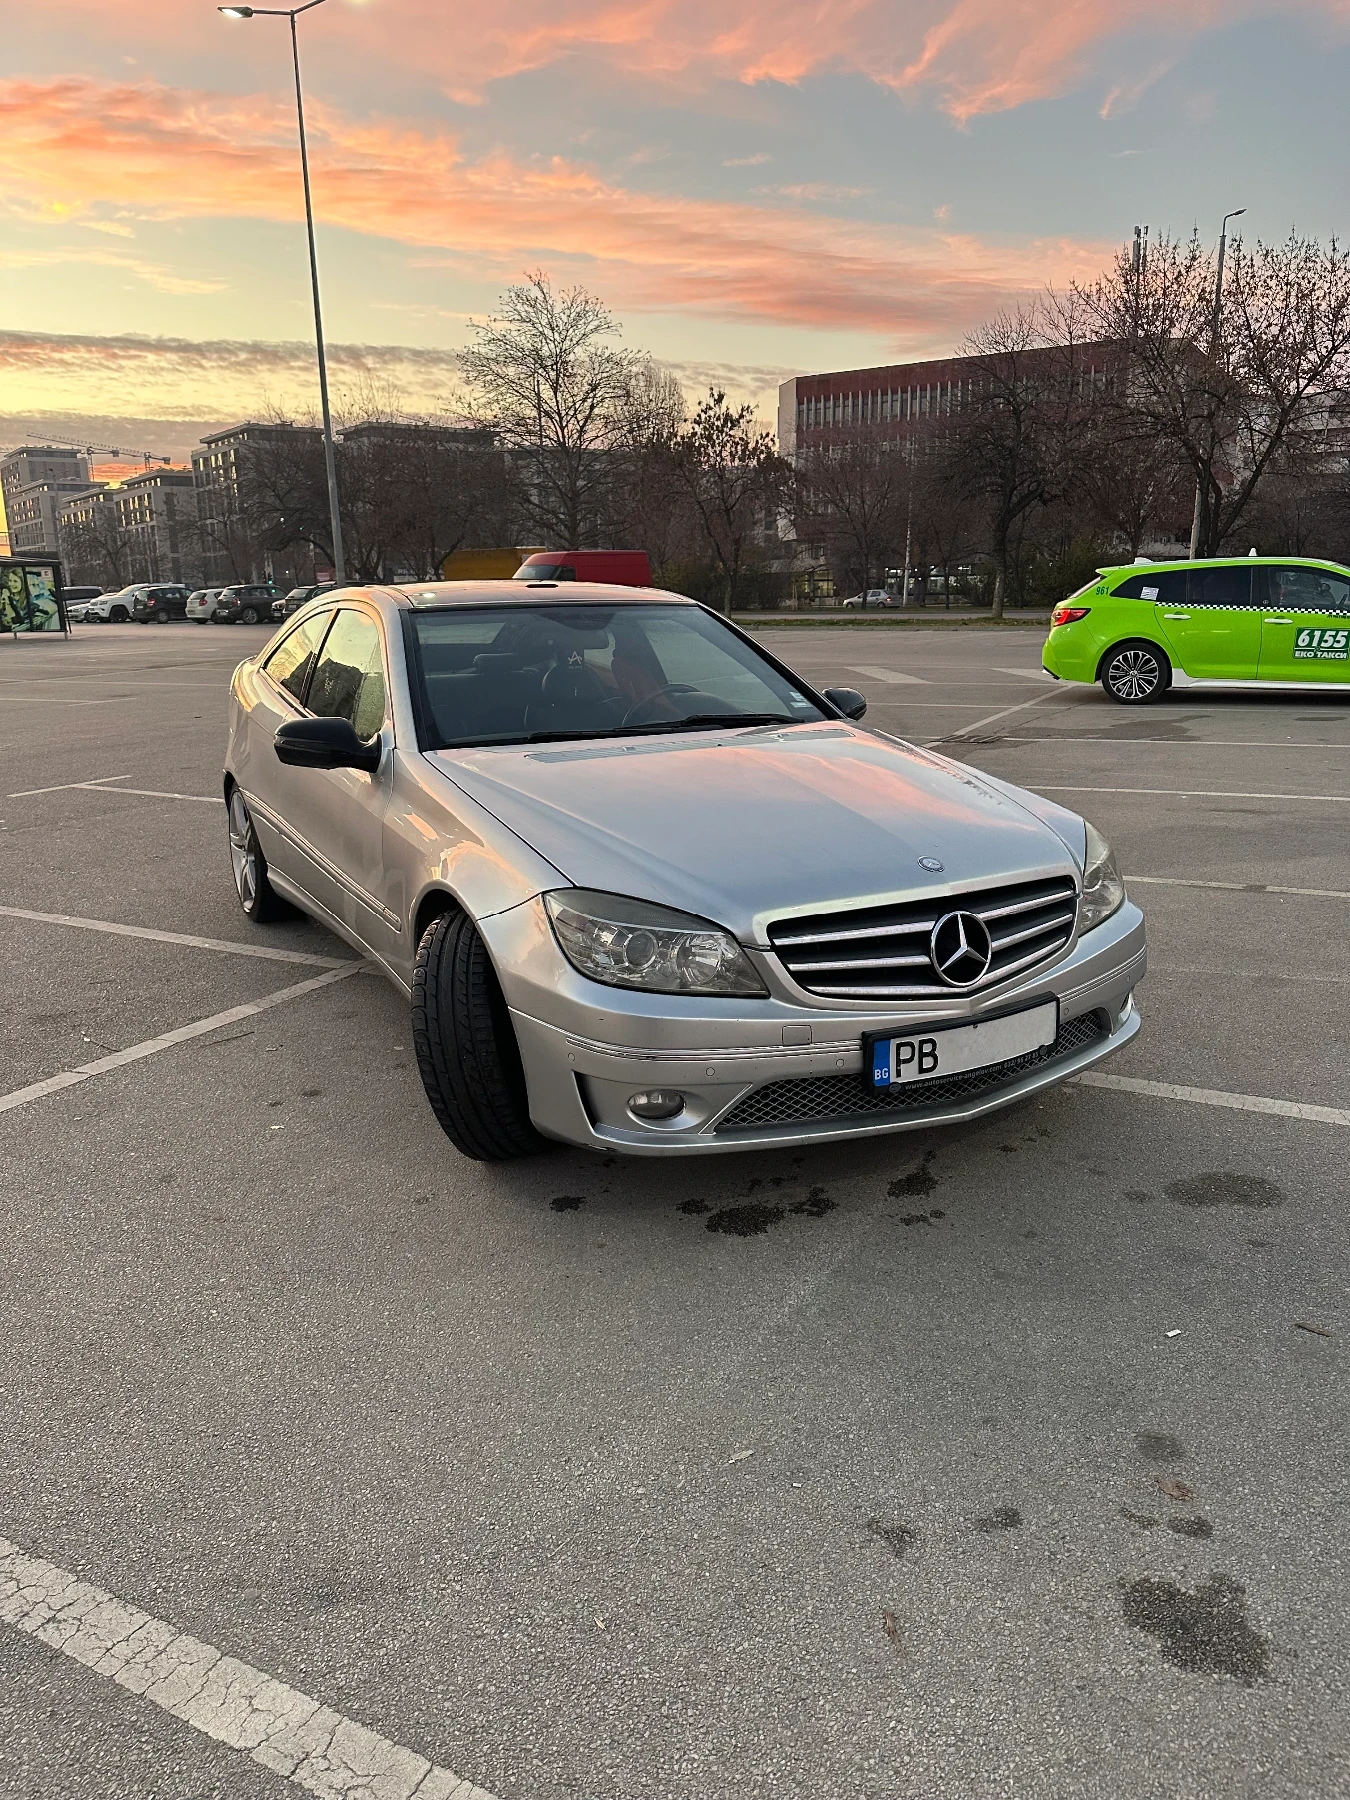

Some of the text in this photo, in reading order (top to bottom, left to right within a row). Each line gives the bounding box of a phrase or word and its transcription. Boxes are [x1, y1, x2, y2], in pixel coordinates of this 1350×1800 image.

[1095, 586, 1110, 596] 961
[1297, 629, 1349, 648] 6155
[1295, 650, 1348, 659] ЕКО ТАКСИ
[895, 1037, 939, 1078] PB
[874, 1067, 889, 1081] BG
